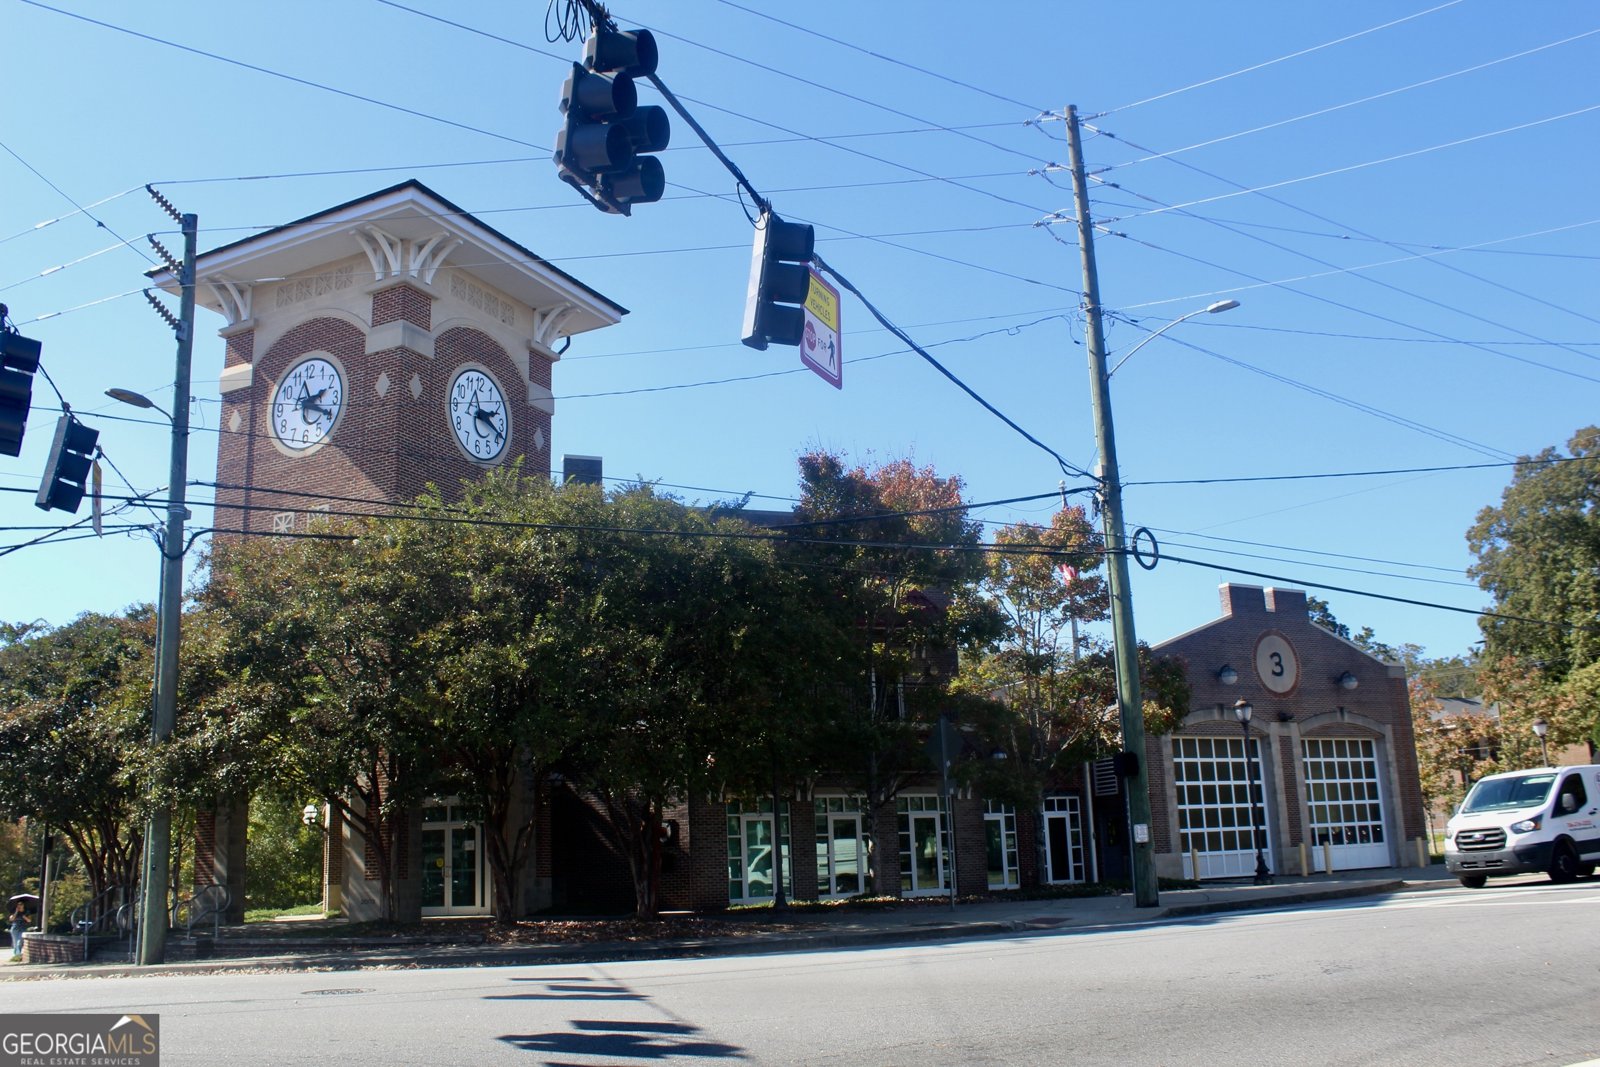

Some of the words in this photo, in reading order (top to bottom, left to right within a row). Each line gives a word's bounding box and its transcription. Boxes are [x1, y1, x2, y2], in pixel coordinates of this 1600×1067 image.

[811, 282, 830, 306] TURNING
[810, 300, 831, 322] VEHICLES
[818, 337, 827, 353] FOR
[294, 371, 302, 387] 11
[304, 364, 315, 380] 12
[320, 365, 325, 380] 1
[328, 374, 335, 389] 2
[466, 375, 474, 392] 11
[475, 376, 485, 393] 12
[282, 385, 293, 401] 10
[332, 390, 339, 405] 3
[456, 382, 466, 399] 10
[488, 387, 493, 401] 1
[276, 403, 284, 418] 9
[452, 397, 459, 412] 9
[494, 401, 501, 415] 2
[280, 419, 287, 433] 8
[315, 423, 322, 437] 5
[456, 416, 462, 431] 8
[498, 418, 505, 433] 3
[290, 428, 297, 443] 7
[303, 430, 309, 444] 6
[464, 430, 470, 446] 7
[494, 433, 501, 448] 4
[474, 440, 481, 454] 6
[485, 440, 492, 455] 5
[1270, 652, 1284, 677] 3
